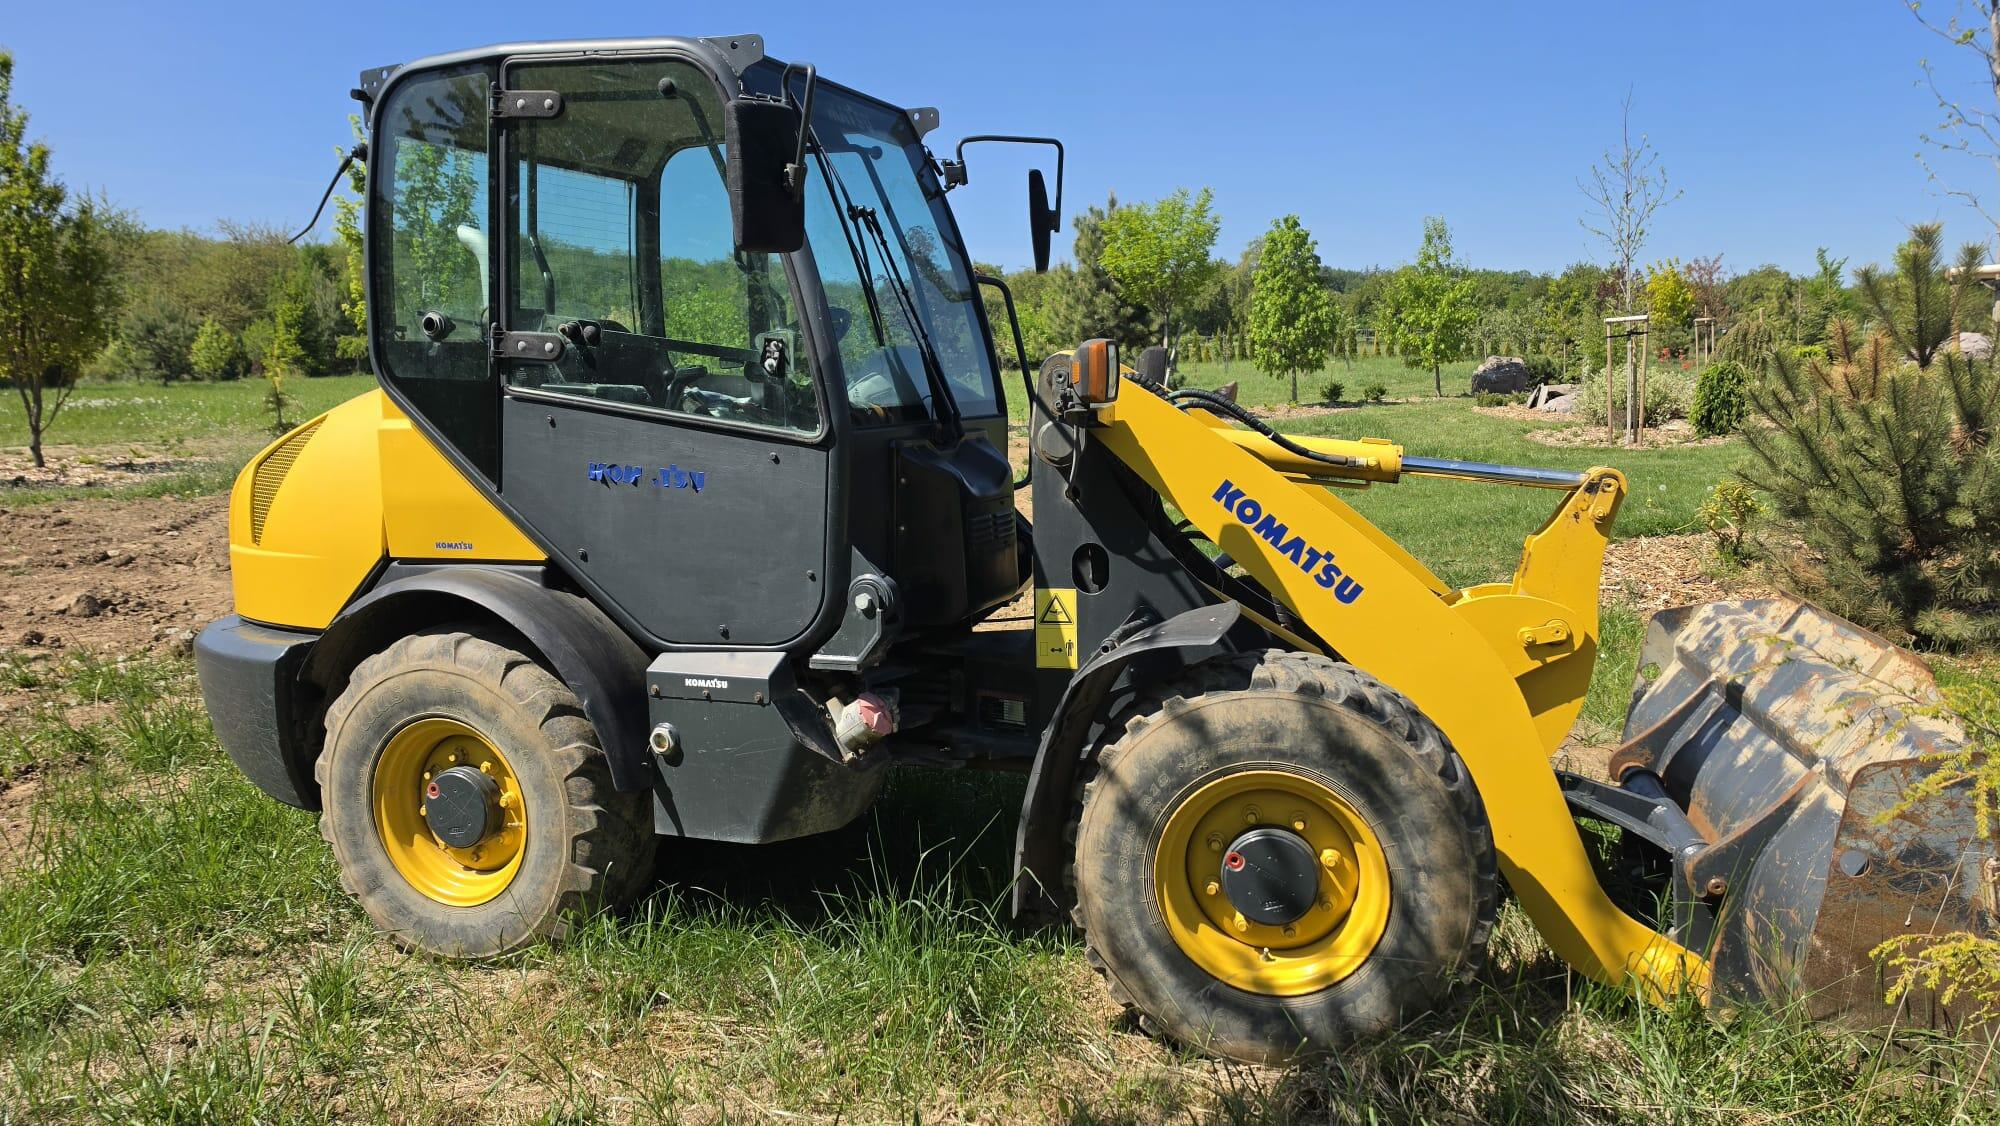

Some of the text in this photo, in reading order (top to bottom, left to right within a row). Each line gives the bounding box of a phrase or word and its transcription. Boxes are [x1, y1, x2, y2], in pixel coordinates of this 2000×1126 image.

[435, 541, 473, 550] KOMATSU
[1211, 479, 1365, 605] KOMATSU
[684, 678, 728, 690] KOMATSU
